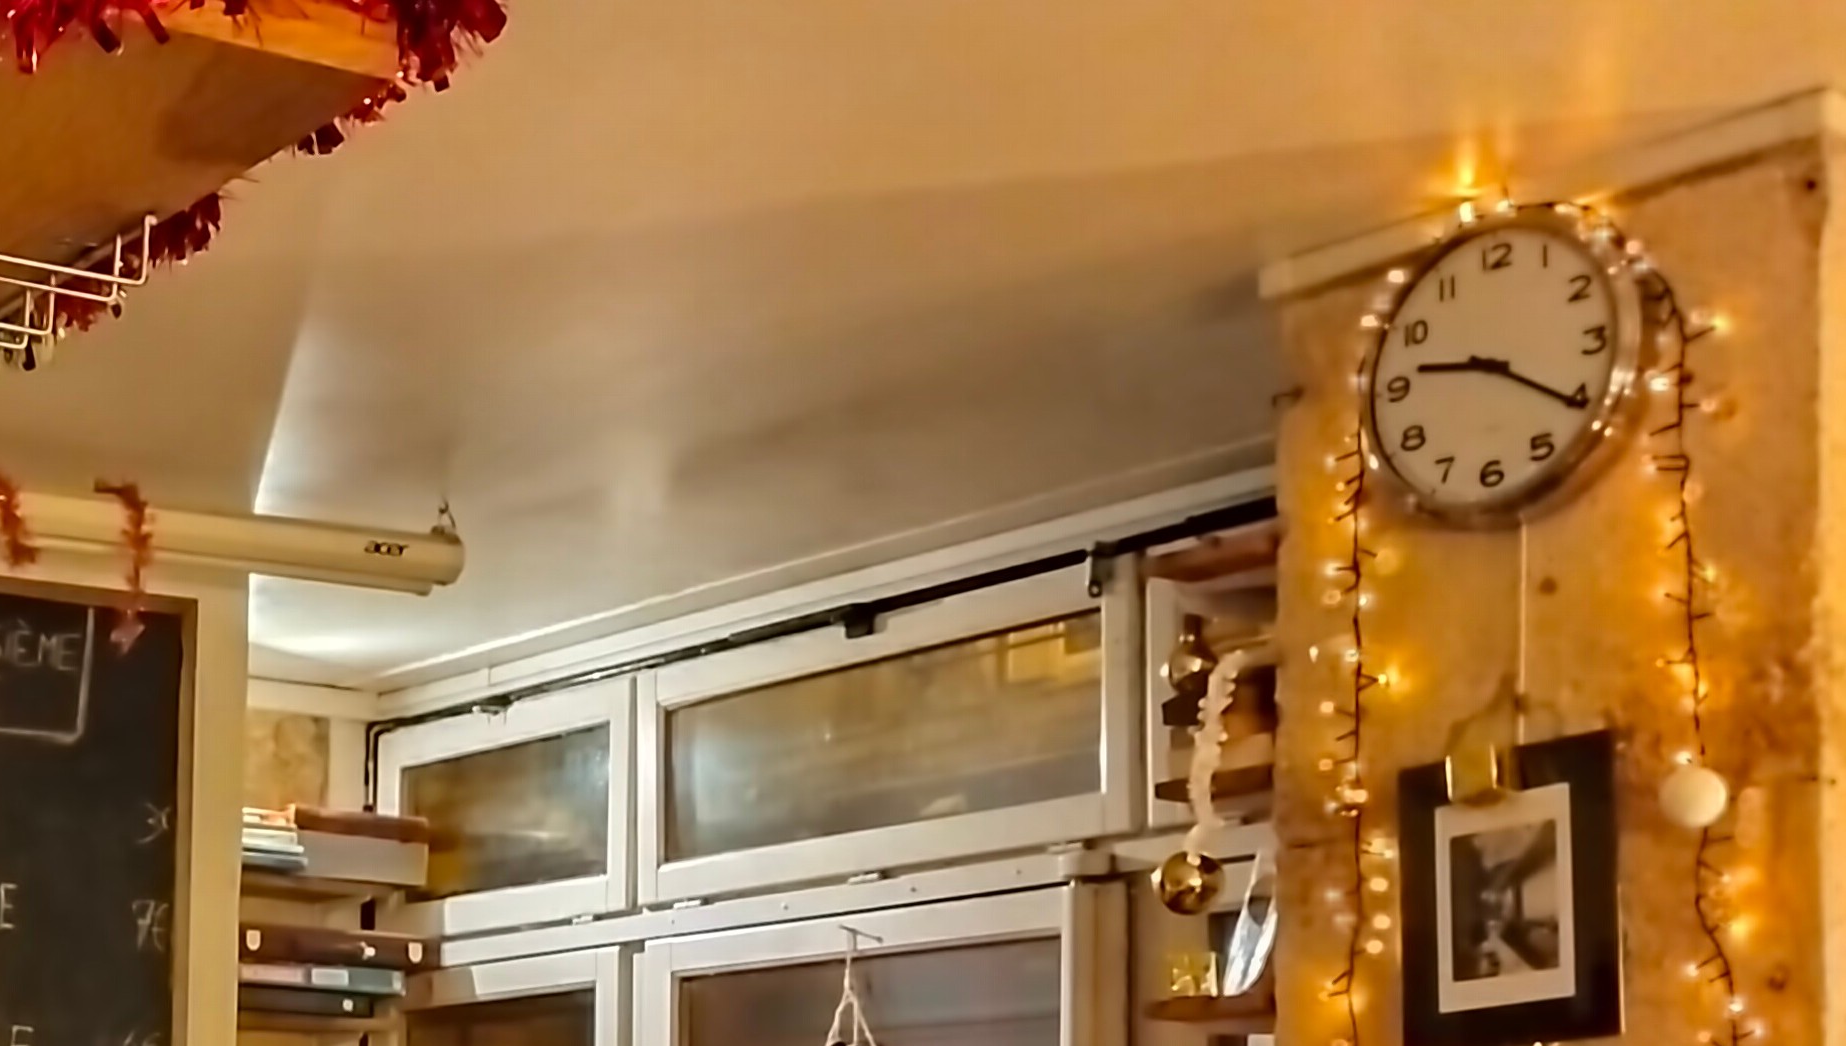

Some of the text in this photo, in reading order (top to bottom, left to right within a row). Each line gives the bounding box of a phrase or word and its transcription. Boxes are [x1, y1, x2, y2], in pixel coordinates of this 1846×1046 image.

[1482, 243, 1513, 271] 12
[1542, 244, 1548, 268] 1
[1439, 275, 1455, 302] 11
[1568, 275, 1592, 303] 2
[1404, 319, 1429, 347] 10
[1581, 324, 1607, 355] 3
[1386, 376, 1411, 403] 9
[1566, 382, 1589, 408] 4
[1400, 424, 1426, 452] 8
[1529, 432, 1555, 462] 5
[1435, 456, 1455, 484] 7
[1479, 459, 1505, 488] 6
